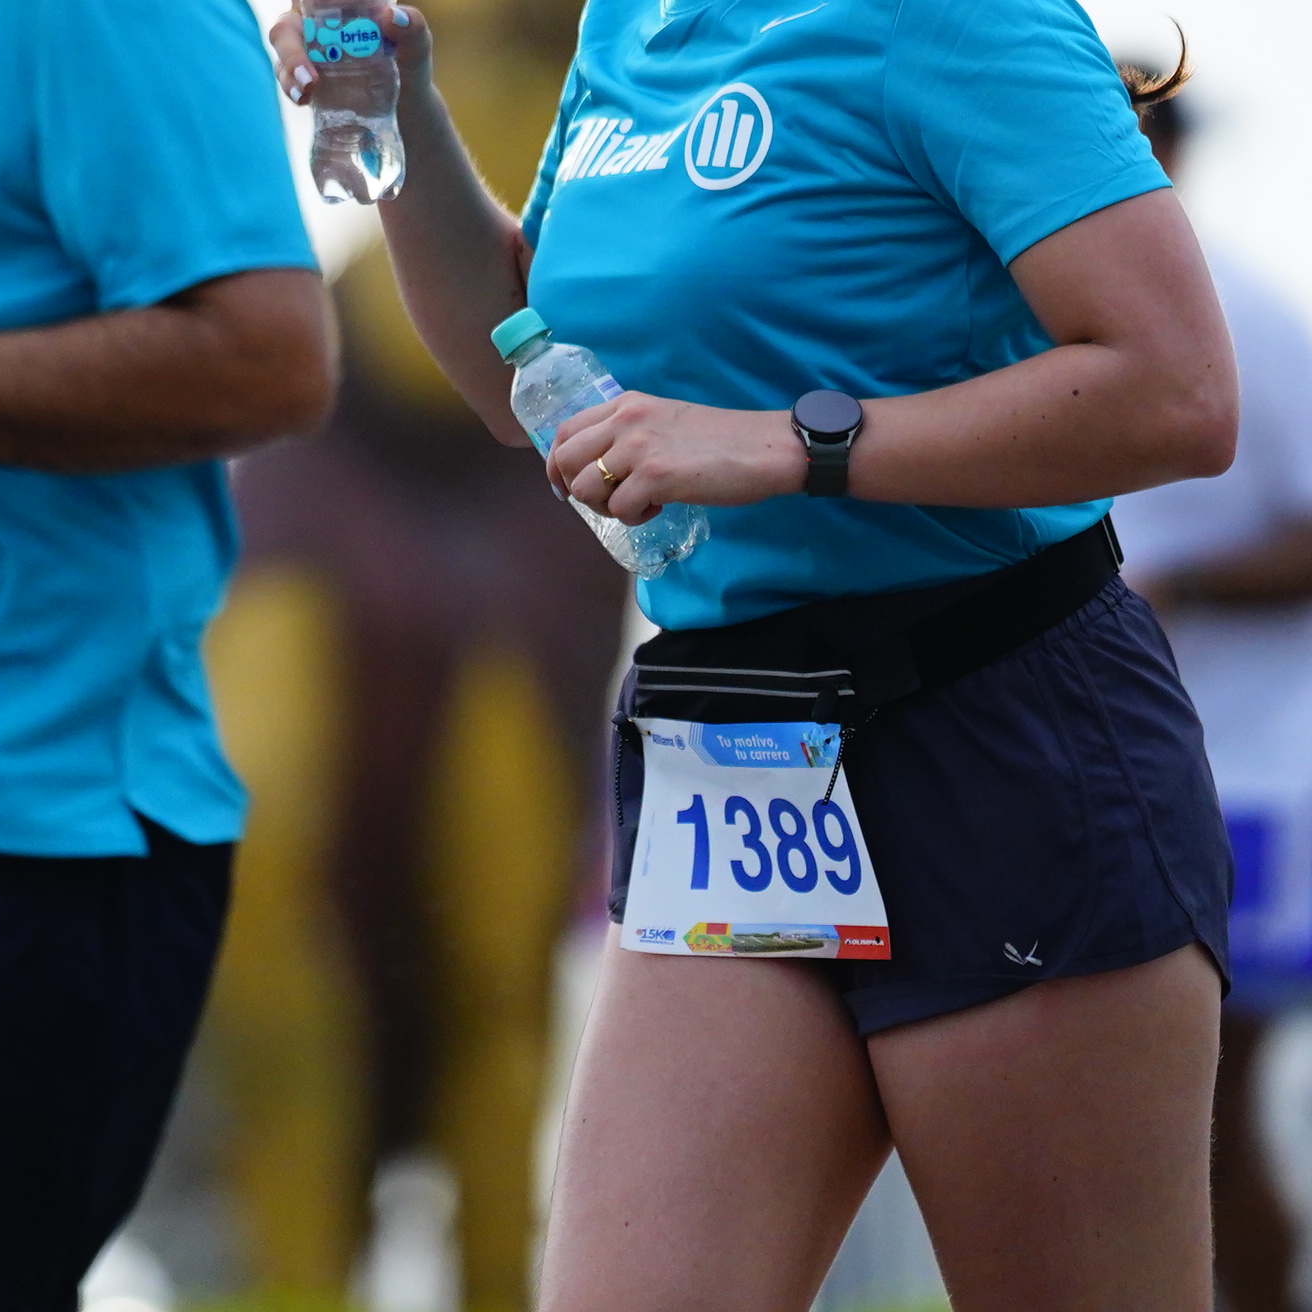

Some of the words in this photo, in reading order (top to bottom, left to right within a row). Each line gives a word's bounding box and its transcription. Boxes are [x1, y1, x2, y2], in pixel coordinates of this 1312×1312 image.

[340, 30, 379, 44] brisa
[716, 735, 732, 748] Tu
[734, 734, 778, 750] motivo,
[735, 749, 748, 760] tu
[750, 750, 790, 761] carrera
[676, 794, 862, 896] 1389
[641, 928, 665, 940] 15K
